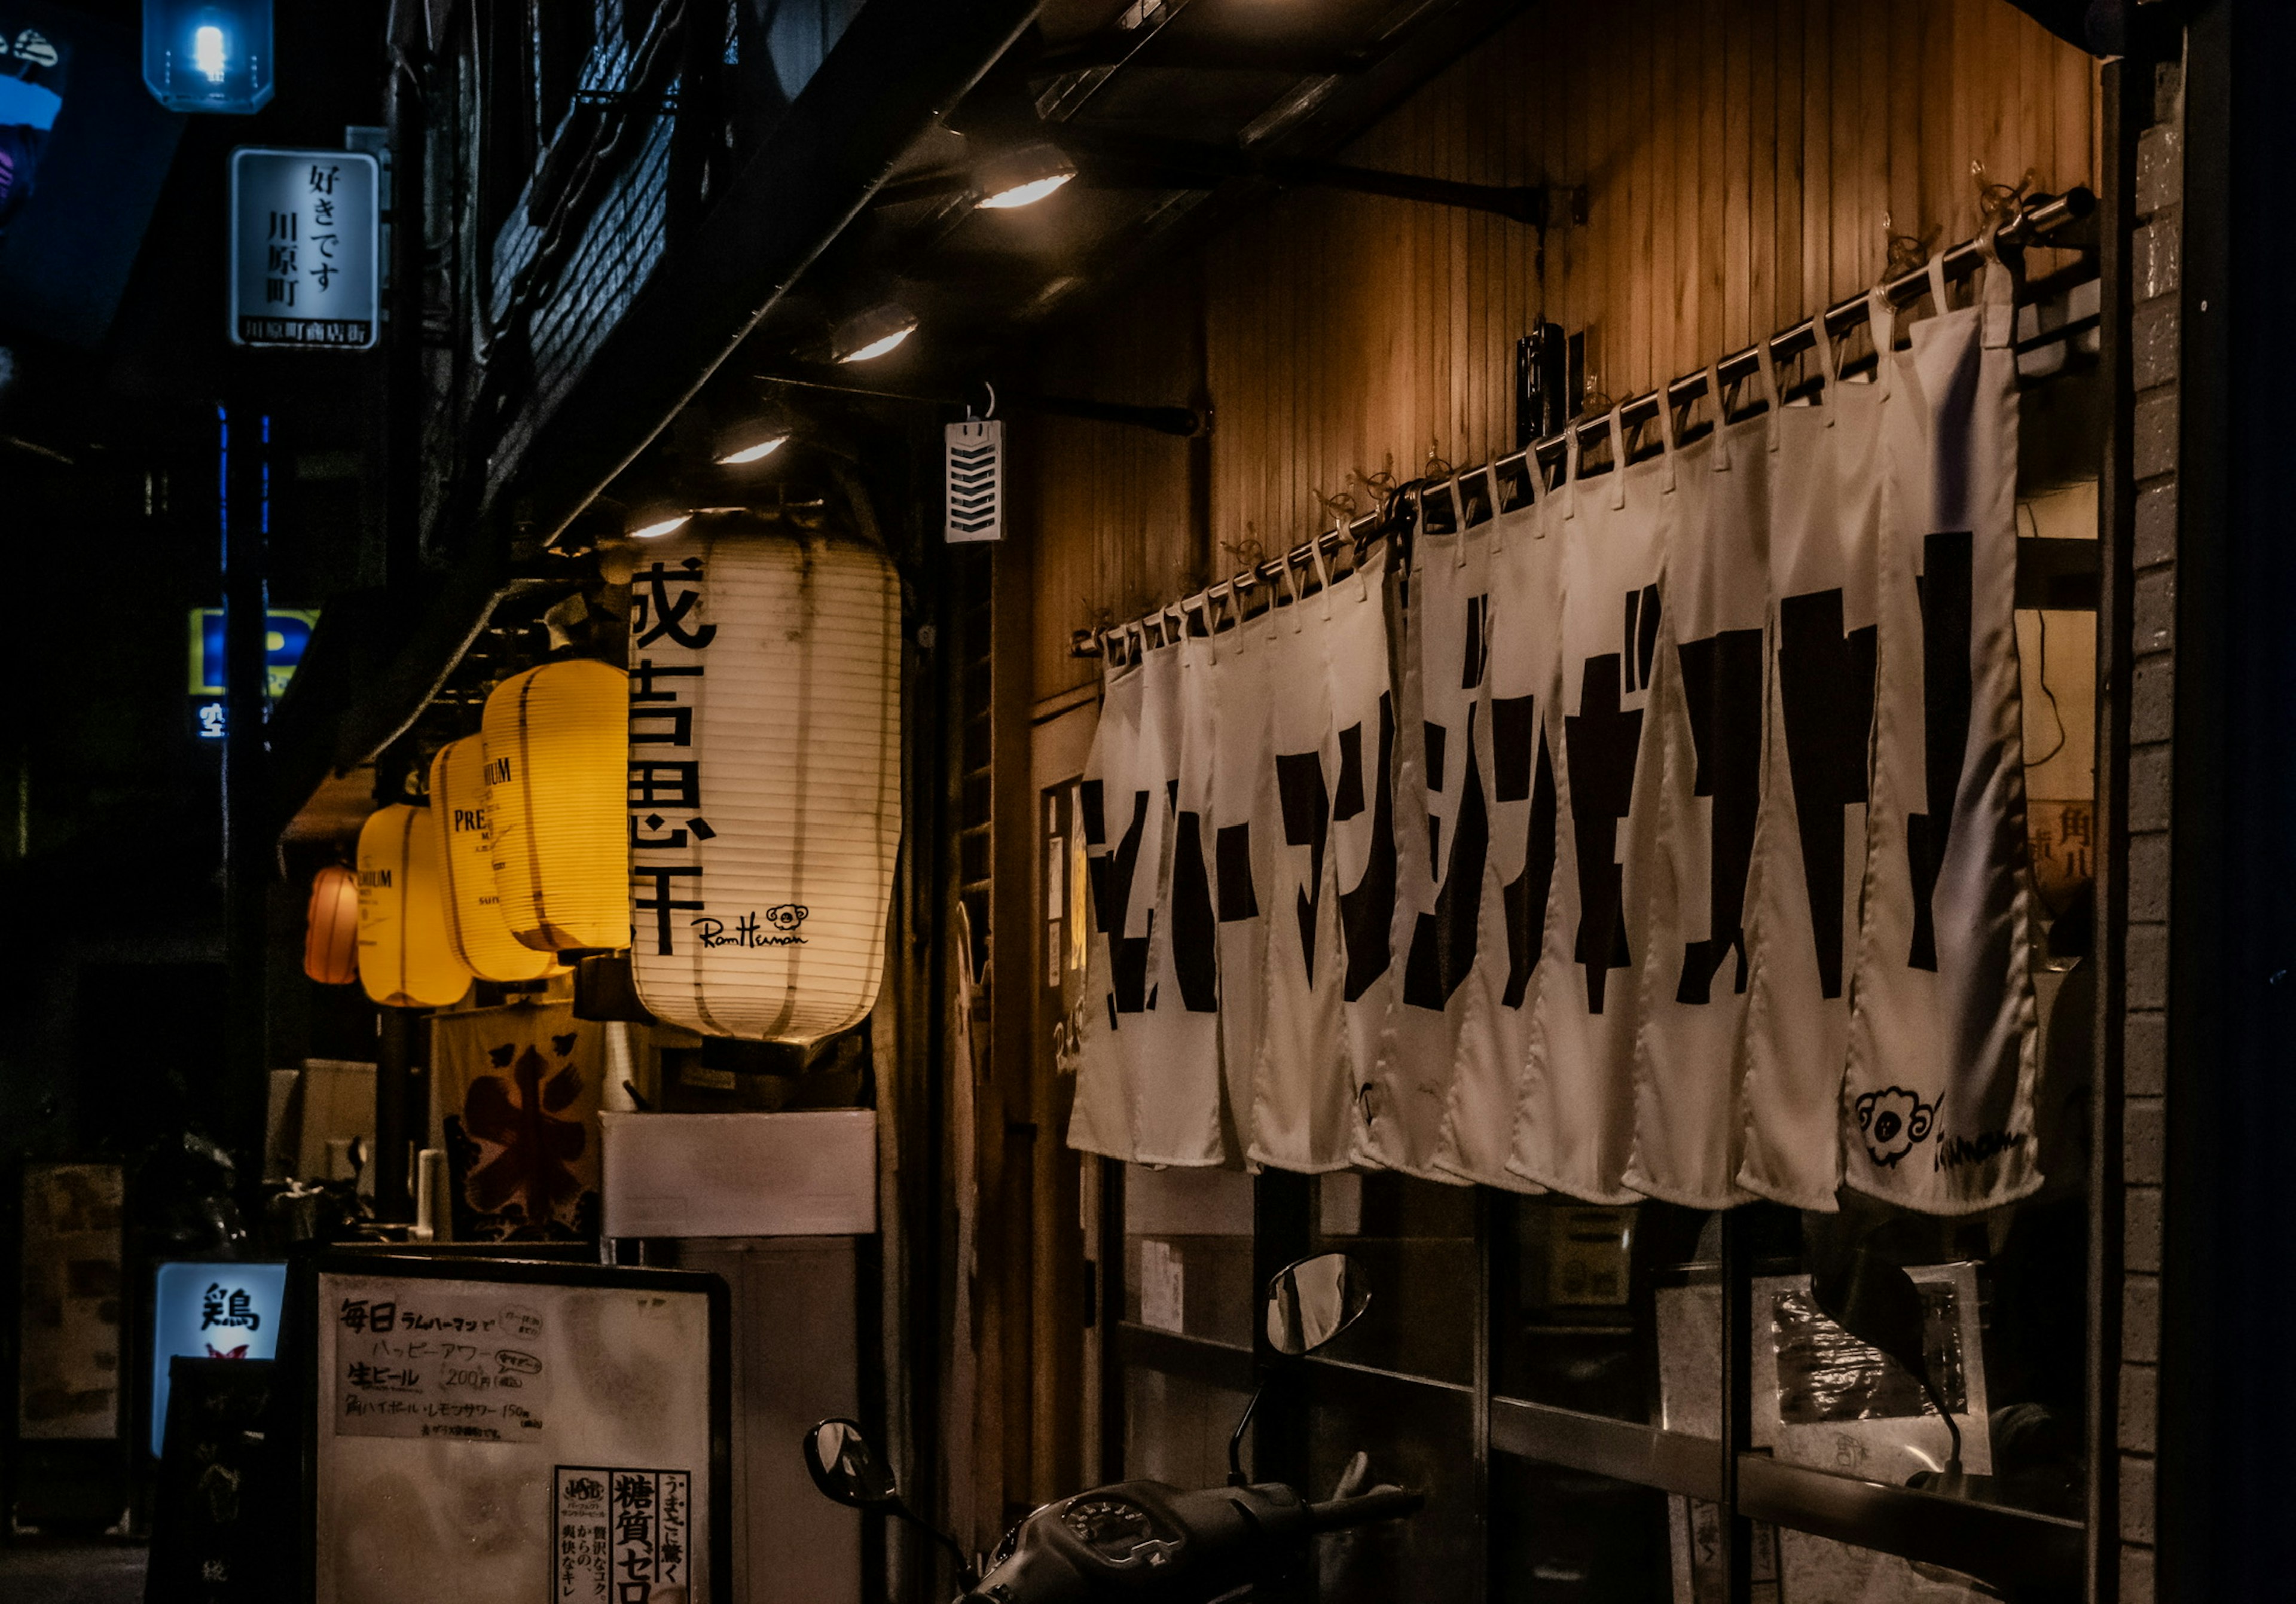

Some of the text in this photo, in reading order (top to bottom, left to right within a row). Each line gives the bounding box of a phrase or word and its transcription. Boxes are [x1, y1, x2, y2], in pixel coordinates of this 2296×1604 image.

[267, 211, 299, 307] 川原町
[310, 164, 340, 293] 好きです
[201, 1283, 259, 1331] 鶏
[340, 1298, 395, 1334] 毎日
[373, 1340, 491, 1362] ハッピーアワー
[561, 1525, 576, 1597] 爽快なキレ
[614, 1474, 655, 1604] 糖質ゼロ
[661, 1475, 685, 1583] うまさに驚く
